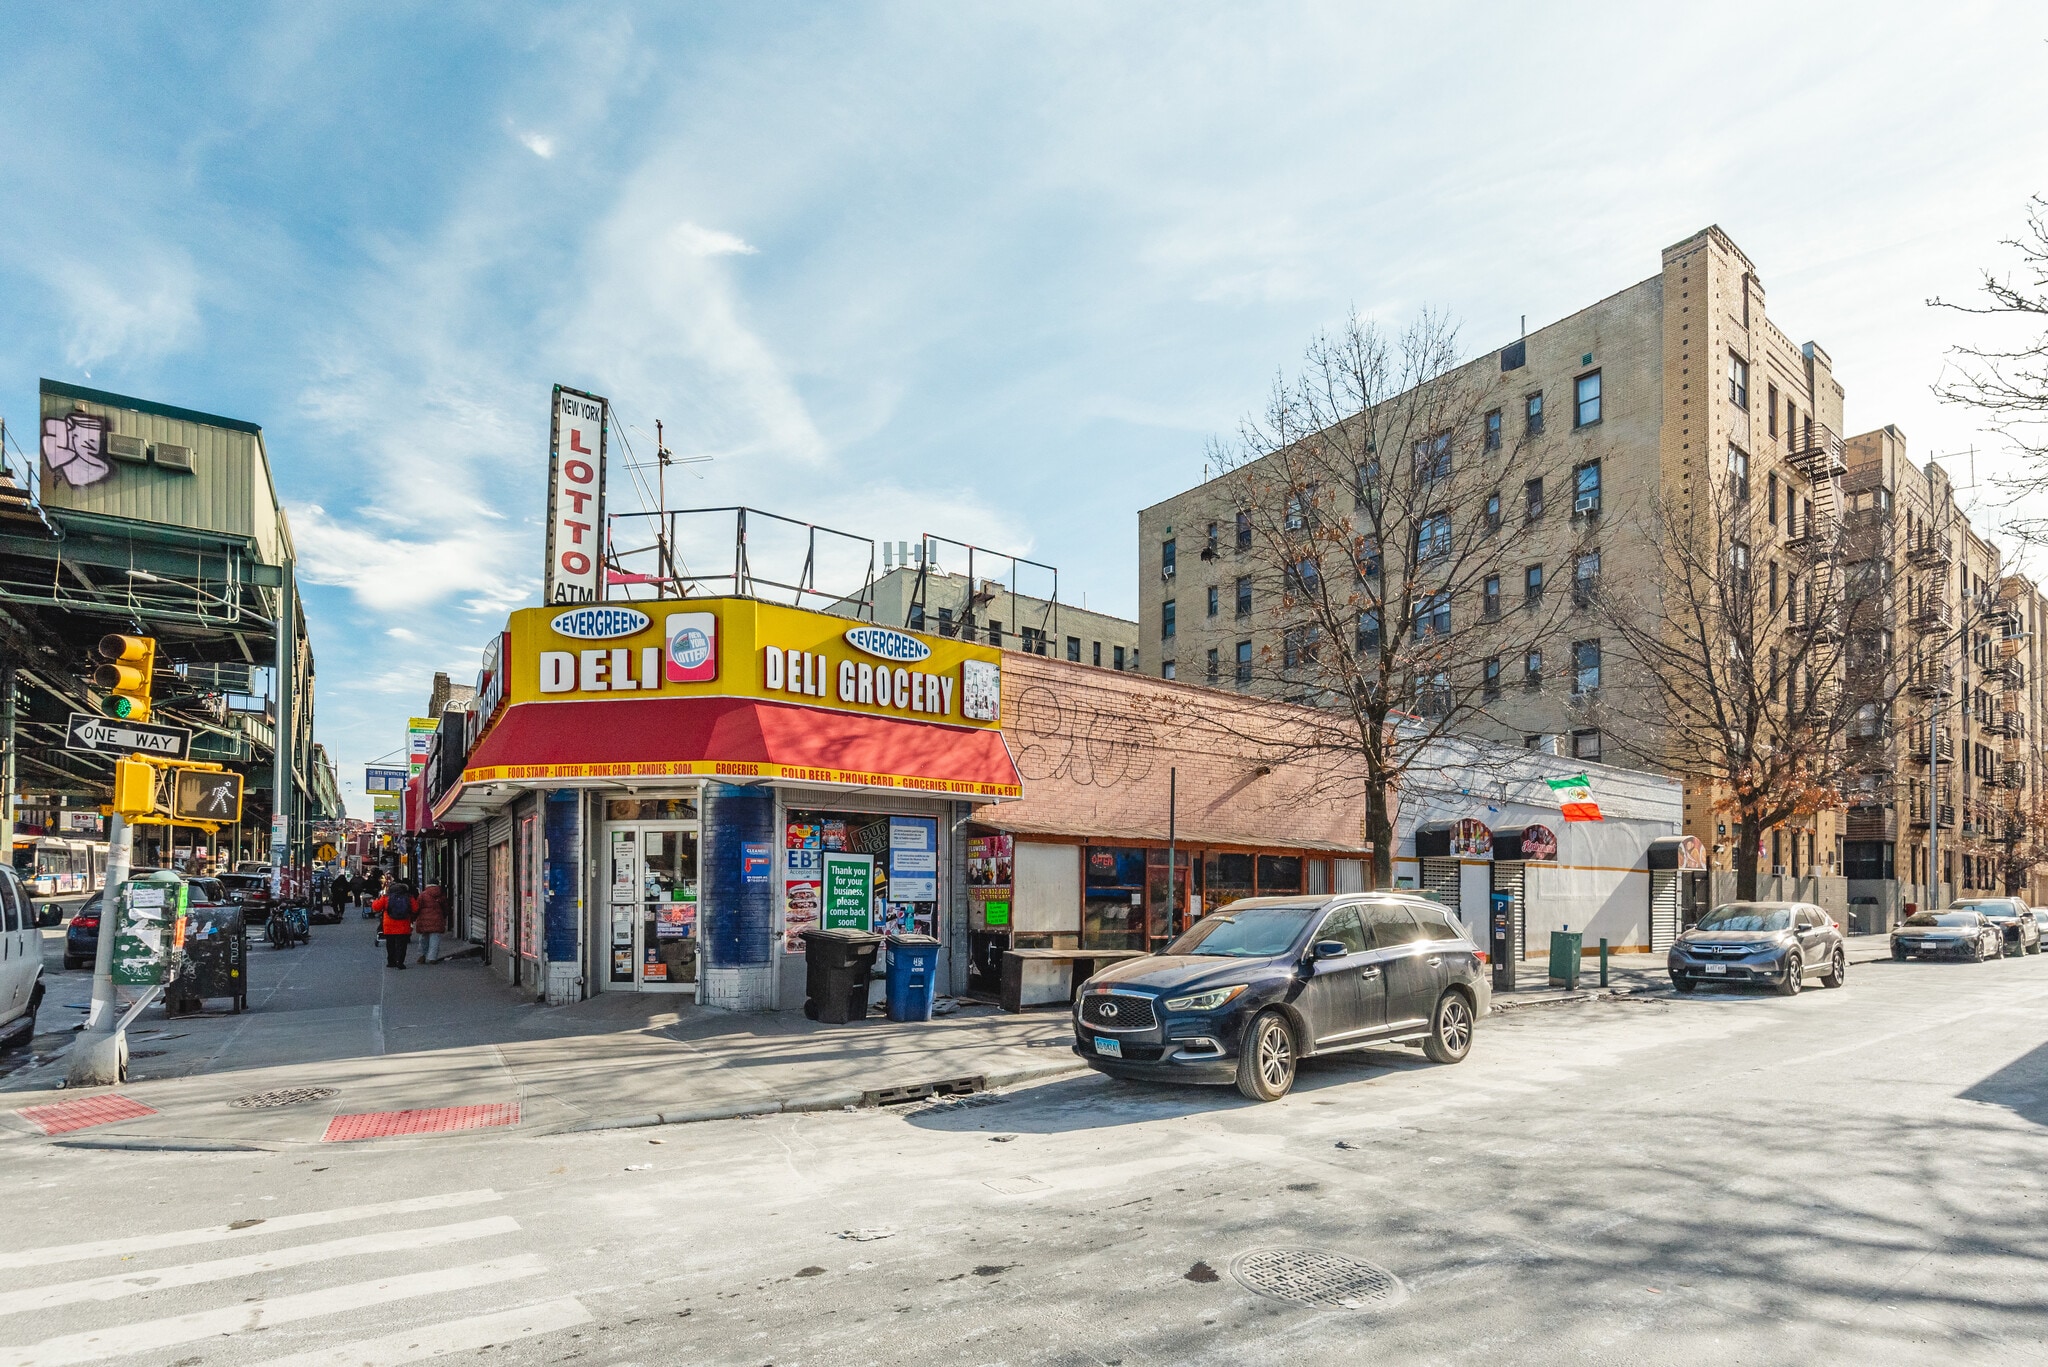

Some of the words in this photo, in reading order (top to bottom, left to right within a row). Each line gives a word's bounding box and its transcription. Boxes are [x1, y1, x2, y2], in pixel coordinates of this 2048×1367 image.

[562, 398, 579, 416] NEW
[581, 403, 600, 422] YORK
[561, 428, 594, 575] LOTTO
[554, 582, 593, 601] ATM
[562, 610, 638, 636] EVERGREEN
[690, 638, 706, 648] YORK
[857, 630, 922, 658] EVERGREEN
[675, 647, 708, 662] LOTTERY
[540, 648, 659, 692] DELI
[766, 645, 826, 698] DELI
[839, 659, 954, 715] GROCERY
[84, 726, 118, 742] ONE
[136, 733, 172, 750] WAY
[508, 767, 524, 778] FOOD
[526, 766, 550, 778] STAMP
[554, 765, 582, 778] LOTTERY
[589, 764, 611, 776] PHONE
[612, 764, 631, 776] CARD
[638, 763, 666, 775] CANDIES
[674, 763, 692, 775] SODA
[716, 763, 758, 776] GROCERIES
[781, 767, 806, 780] COLD
[809, 770, 831, 782] BEER
[840, 772, 868, 785] PHONE
[870, 775, 894, 787] CARD
[902, 778, 947, 791] GROCERIES
[951, 782, 974, 793] LOTTO
[981, 785, 996, 795] ATM
[1004, 786, 1017, 796] EBT
[860, 822, 888, 842] BUD
[857, 836, 888, 852] LIGH
[788, 850, 821, 868] EBT
[1091, 854, 1113, 866] OPEN
[831, 865, 852, 875] Thank
[854, 868, 866, 877] you
[835, 876, 846, 885] for
[847, 878, 863, 887] your
[834, 886, 864, 896] business,
[836, 897, 859, 907] please
[1498, 902, 1504, 910] P
[850, 907, 865, 916] back
[838, 918, 856, 926] soon!
